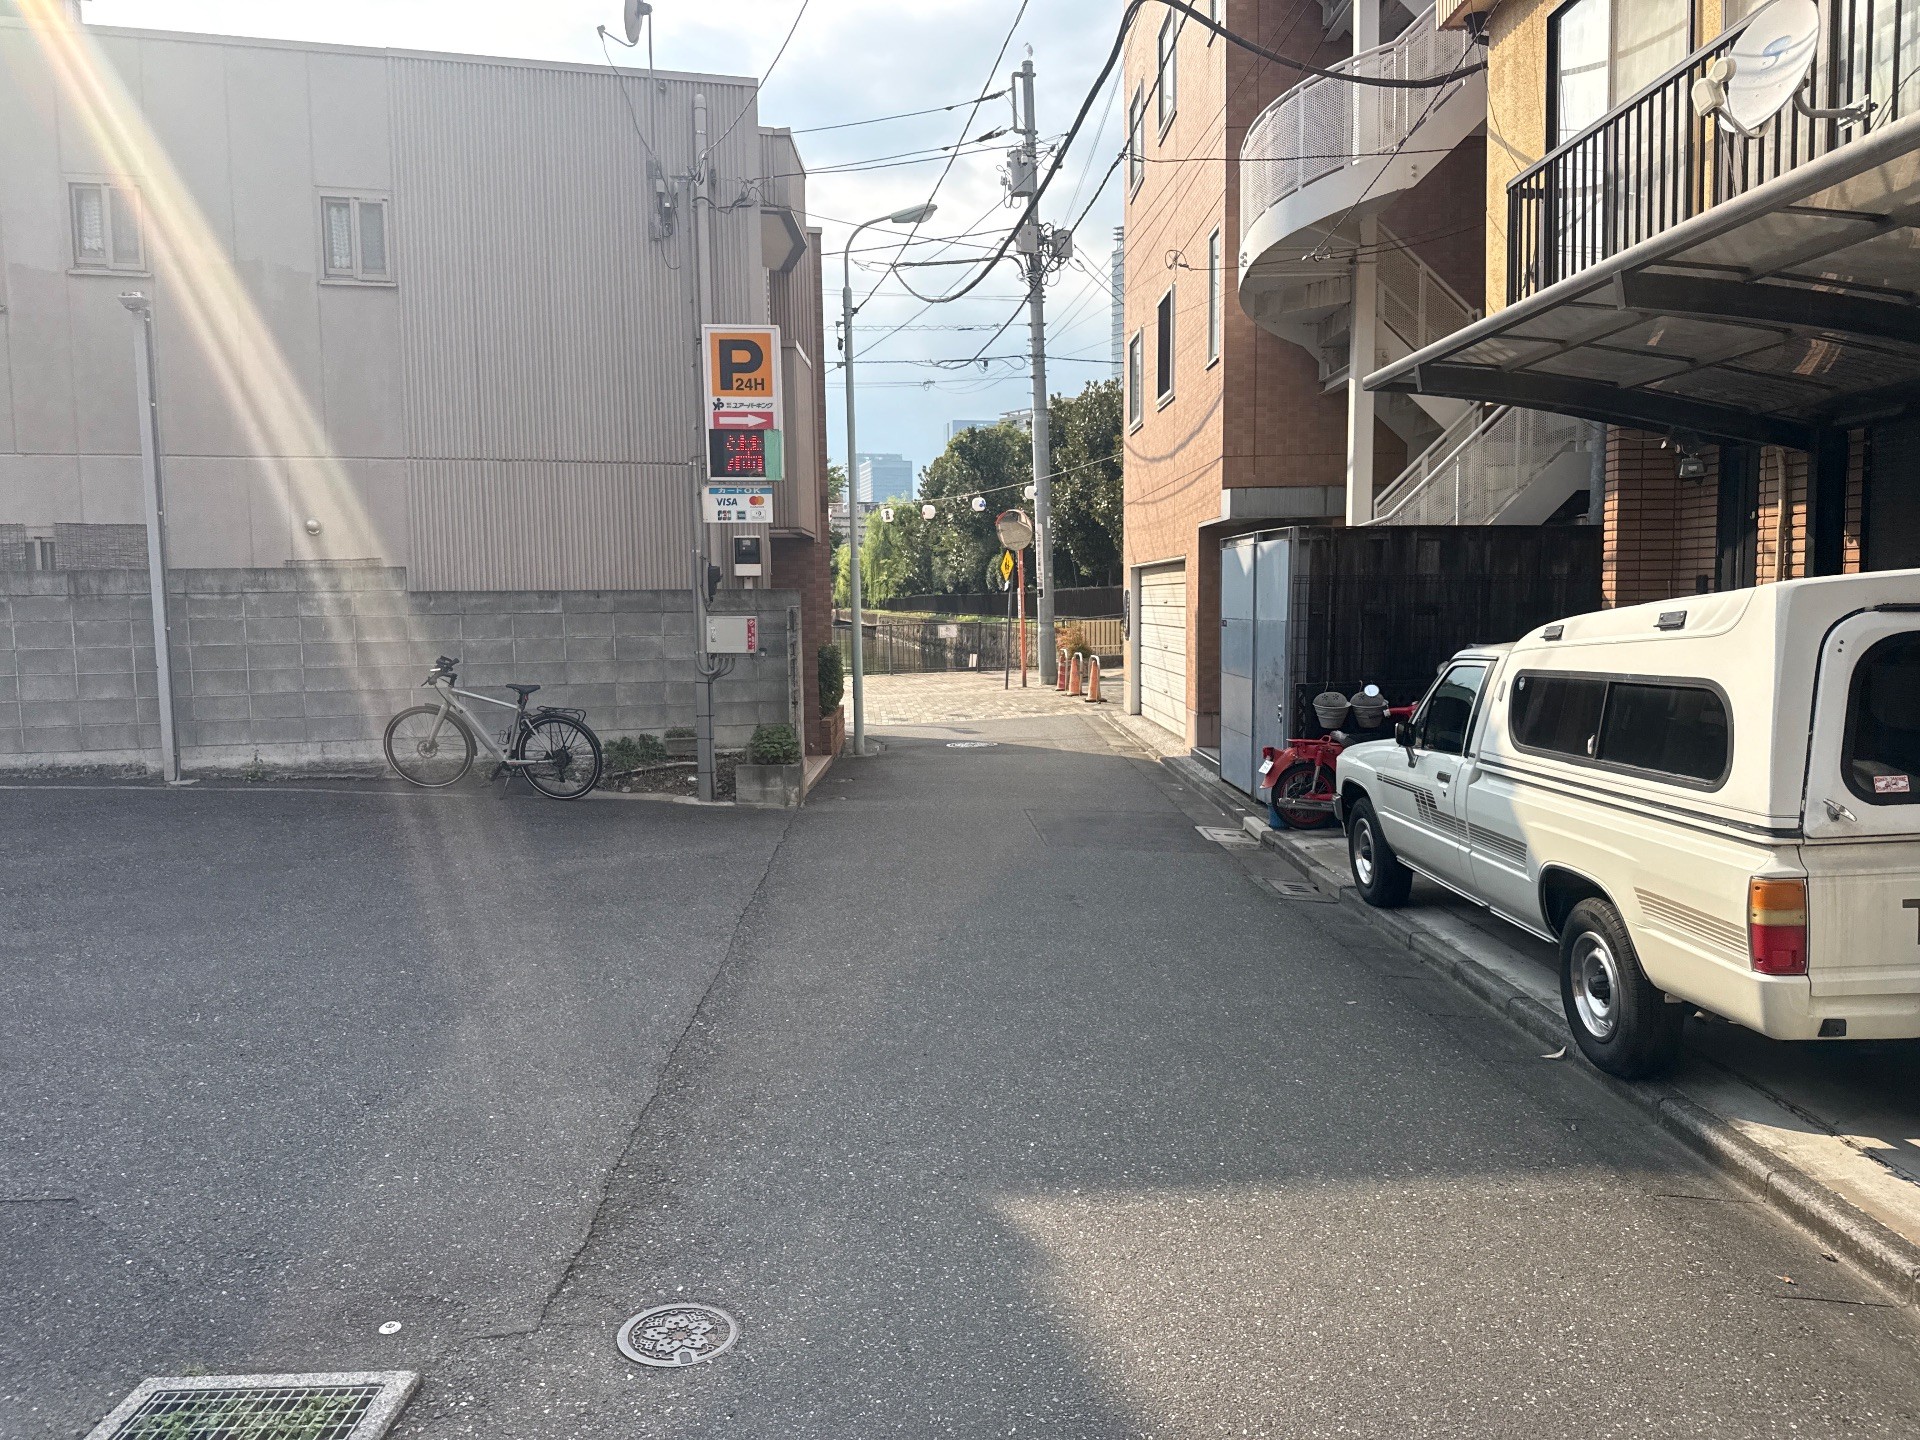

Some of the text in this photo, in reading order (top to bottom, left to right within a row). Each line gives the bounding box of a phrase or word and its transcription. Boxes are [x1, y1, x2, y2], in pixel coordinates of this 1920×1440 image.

[719, 339, 763, 390] P
[735, 378, 765, 391] 24H
[716, 497, 738, 506] VISA
